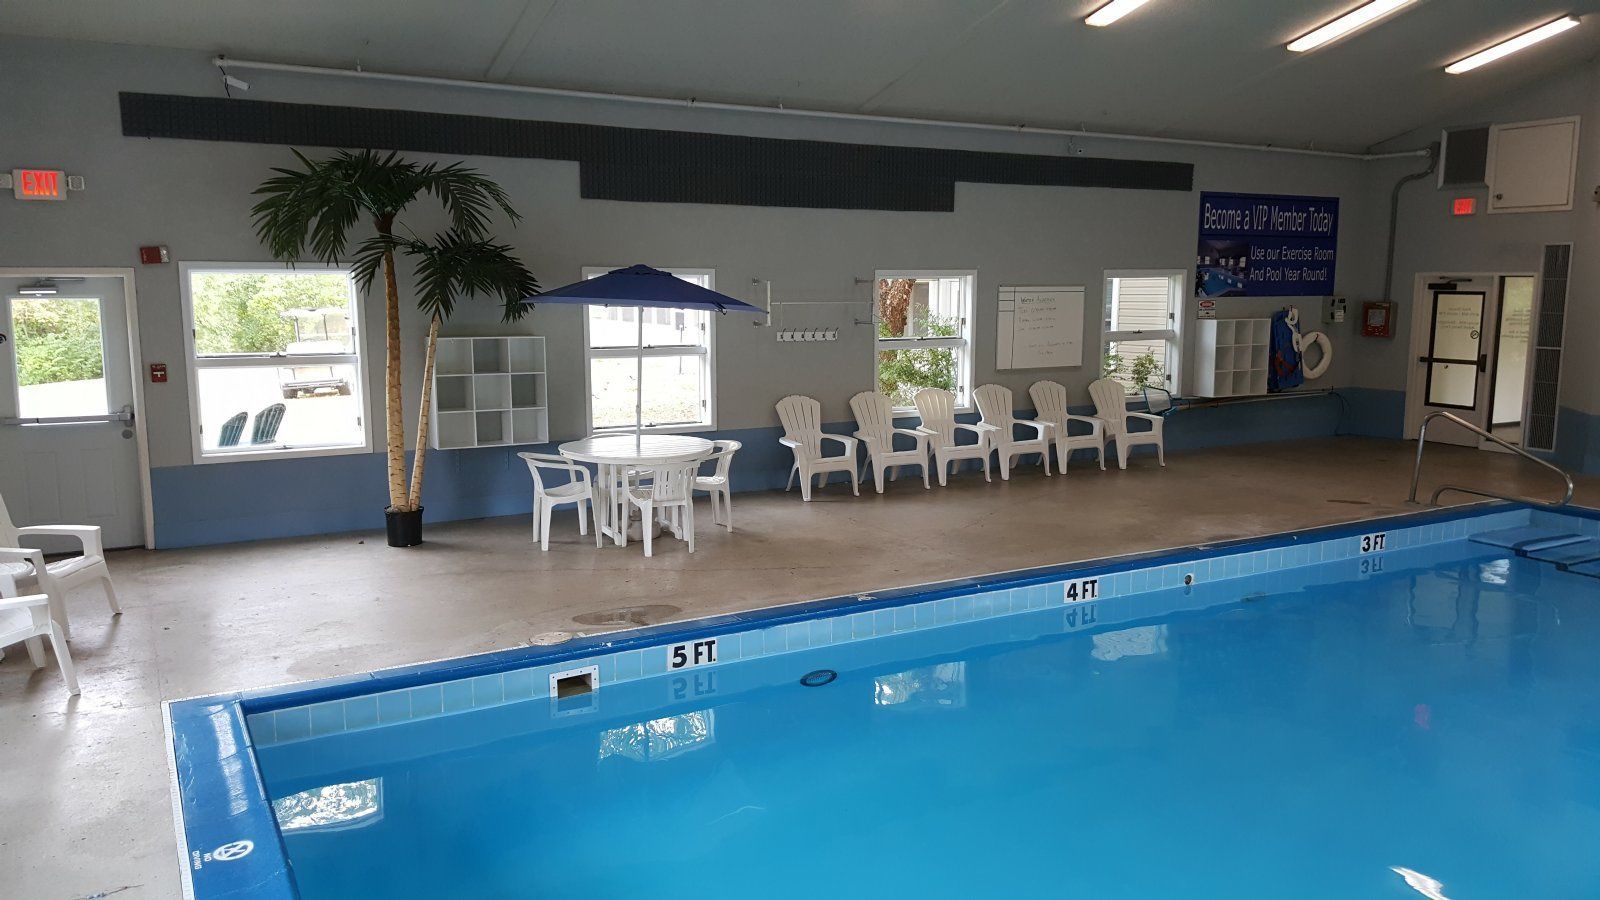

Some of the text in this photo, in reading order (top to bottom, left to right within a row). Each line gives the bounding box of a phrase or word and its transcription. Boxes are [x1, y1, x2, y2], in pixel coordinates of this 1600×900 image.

[22, 171, 58, 196] EXIT
[1204, 203, 1333, 235] Become a VIP Member Today
[1250, 246, 1334, 261] Use our Exercise Room
[1250, 267, 1327, 281] And Pool Year Round!
[1362, 536, 1371, 552] 3
[1067, 580, 1097, 601] 4 FT.
[672, 640, 716, 668] 5 FT.
[192, 850, 202, 870] DIVING
[203, 853, 212, 862] NO
